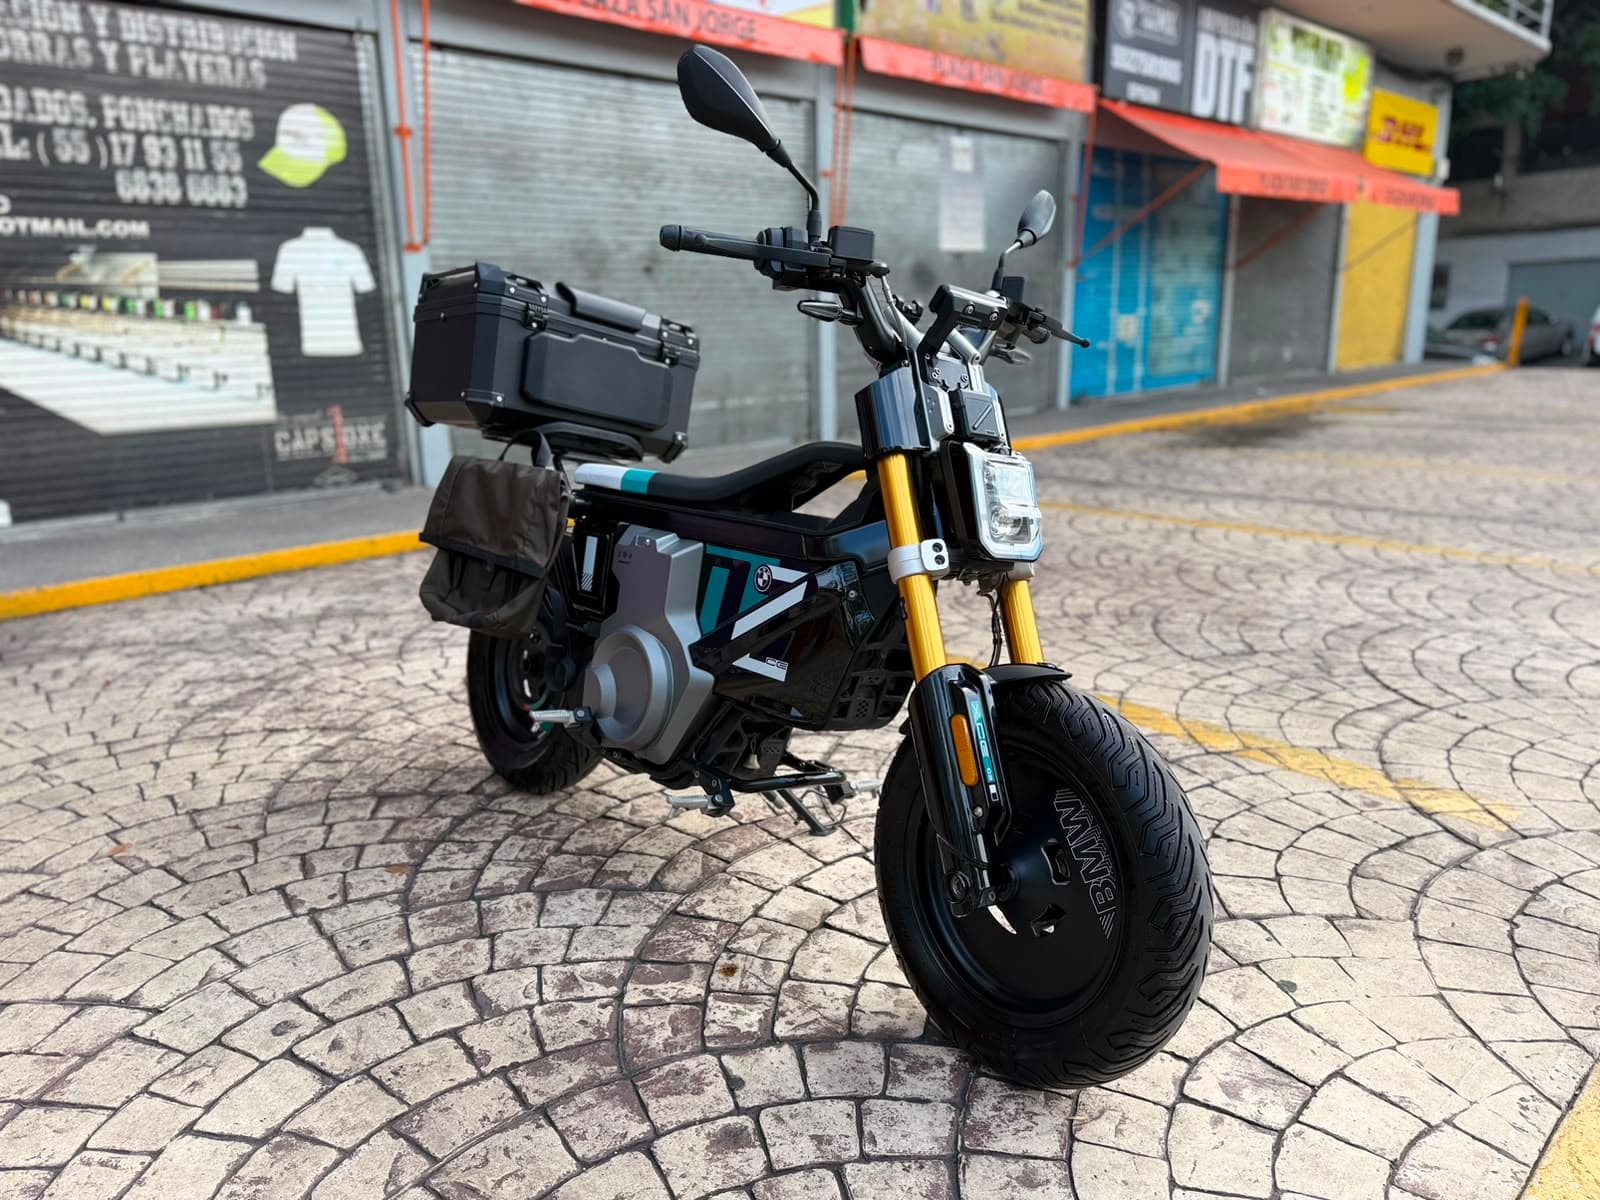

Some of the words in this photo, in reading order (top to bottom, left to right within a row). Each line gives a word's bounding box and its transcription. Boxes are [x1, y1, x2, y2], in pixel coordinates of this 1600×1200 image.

[88, 4, 109, 38] Y
[646, 0, 689, 29] SAN
[696, 12, 757, 42] JORGE
[97, 40, 119, 74] Y
[1191, 31, 1256, 124] DTF
[181, 136, 208, 171] 11
[1053, 798, 1117, 915] BMW
